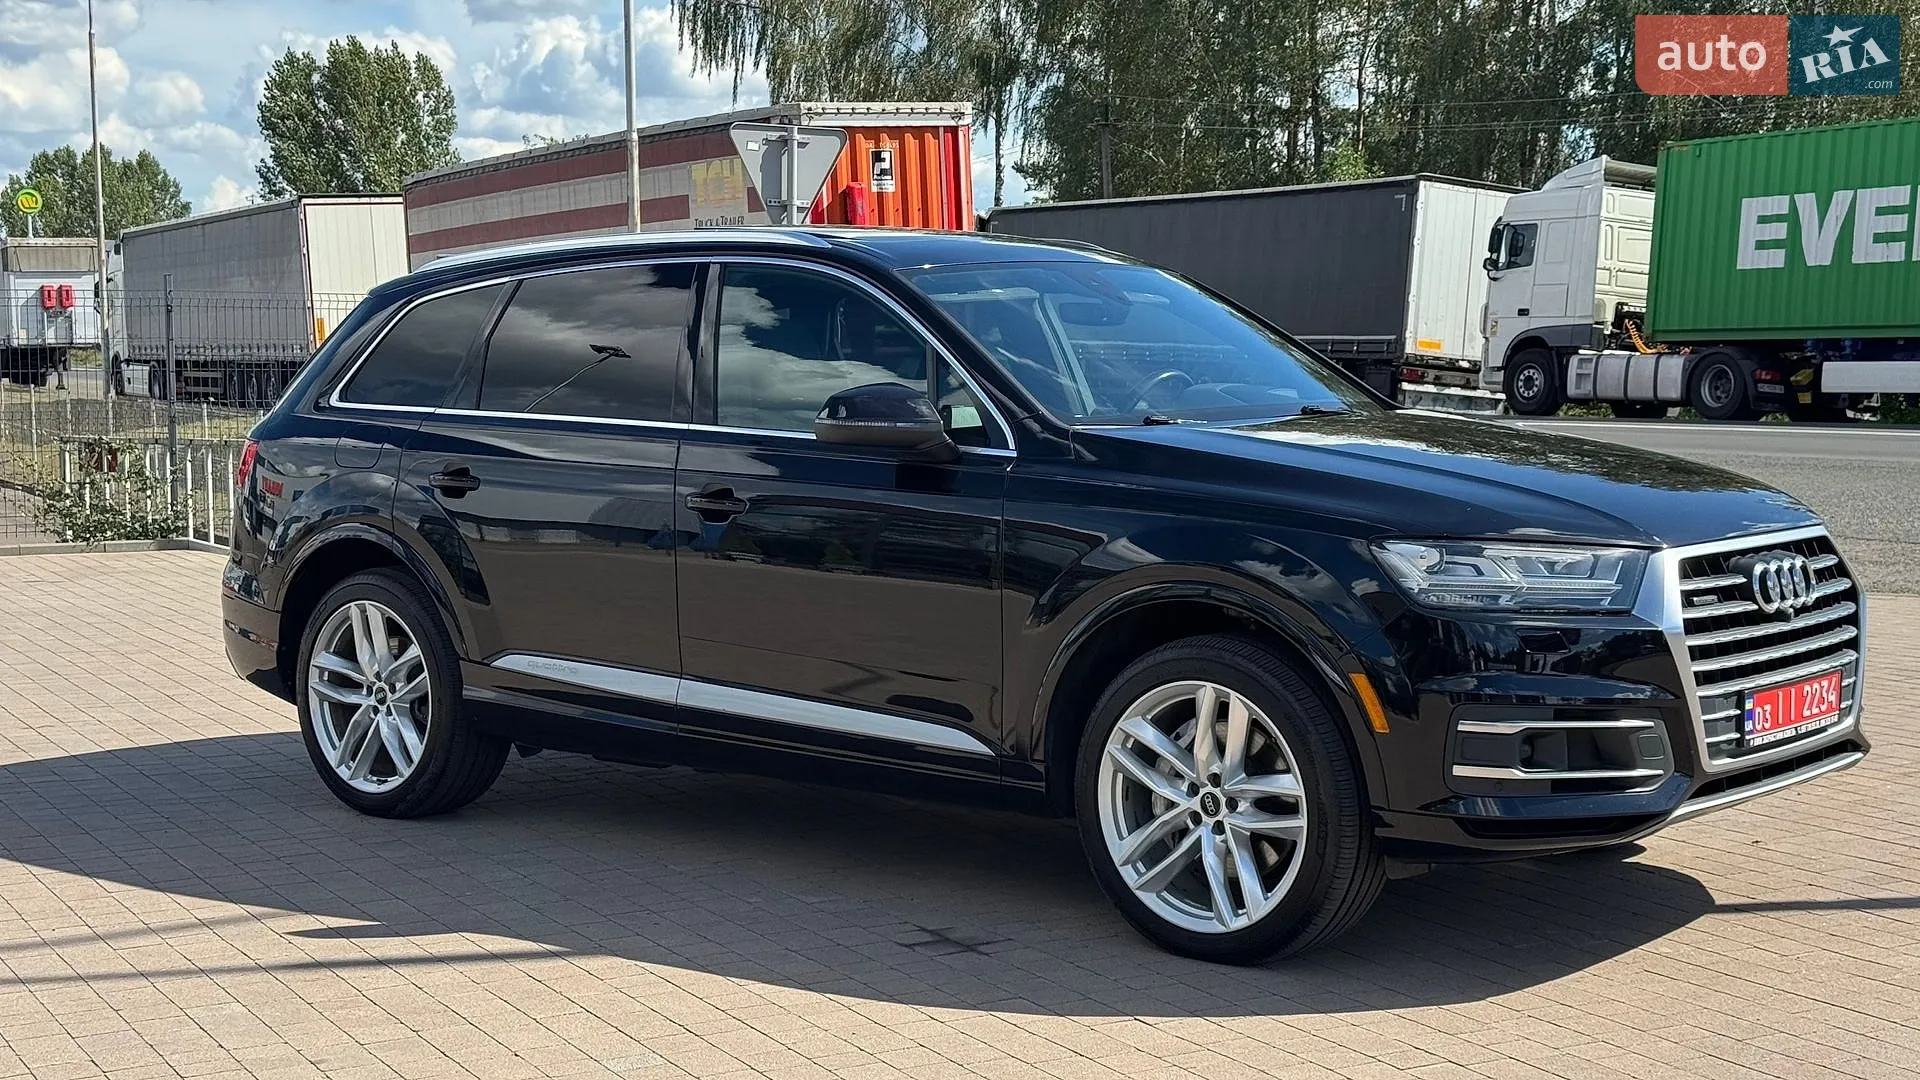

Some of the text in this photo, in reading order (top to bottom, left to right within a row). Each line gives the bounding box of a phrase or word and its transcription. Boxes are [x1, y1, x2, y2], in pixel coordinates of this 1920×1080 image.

[1736, 184, 1920, 270] EVE
[1754, 704, 1772, 731] 03
[1802, 677, 1837, 718] 2234
